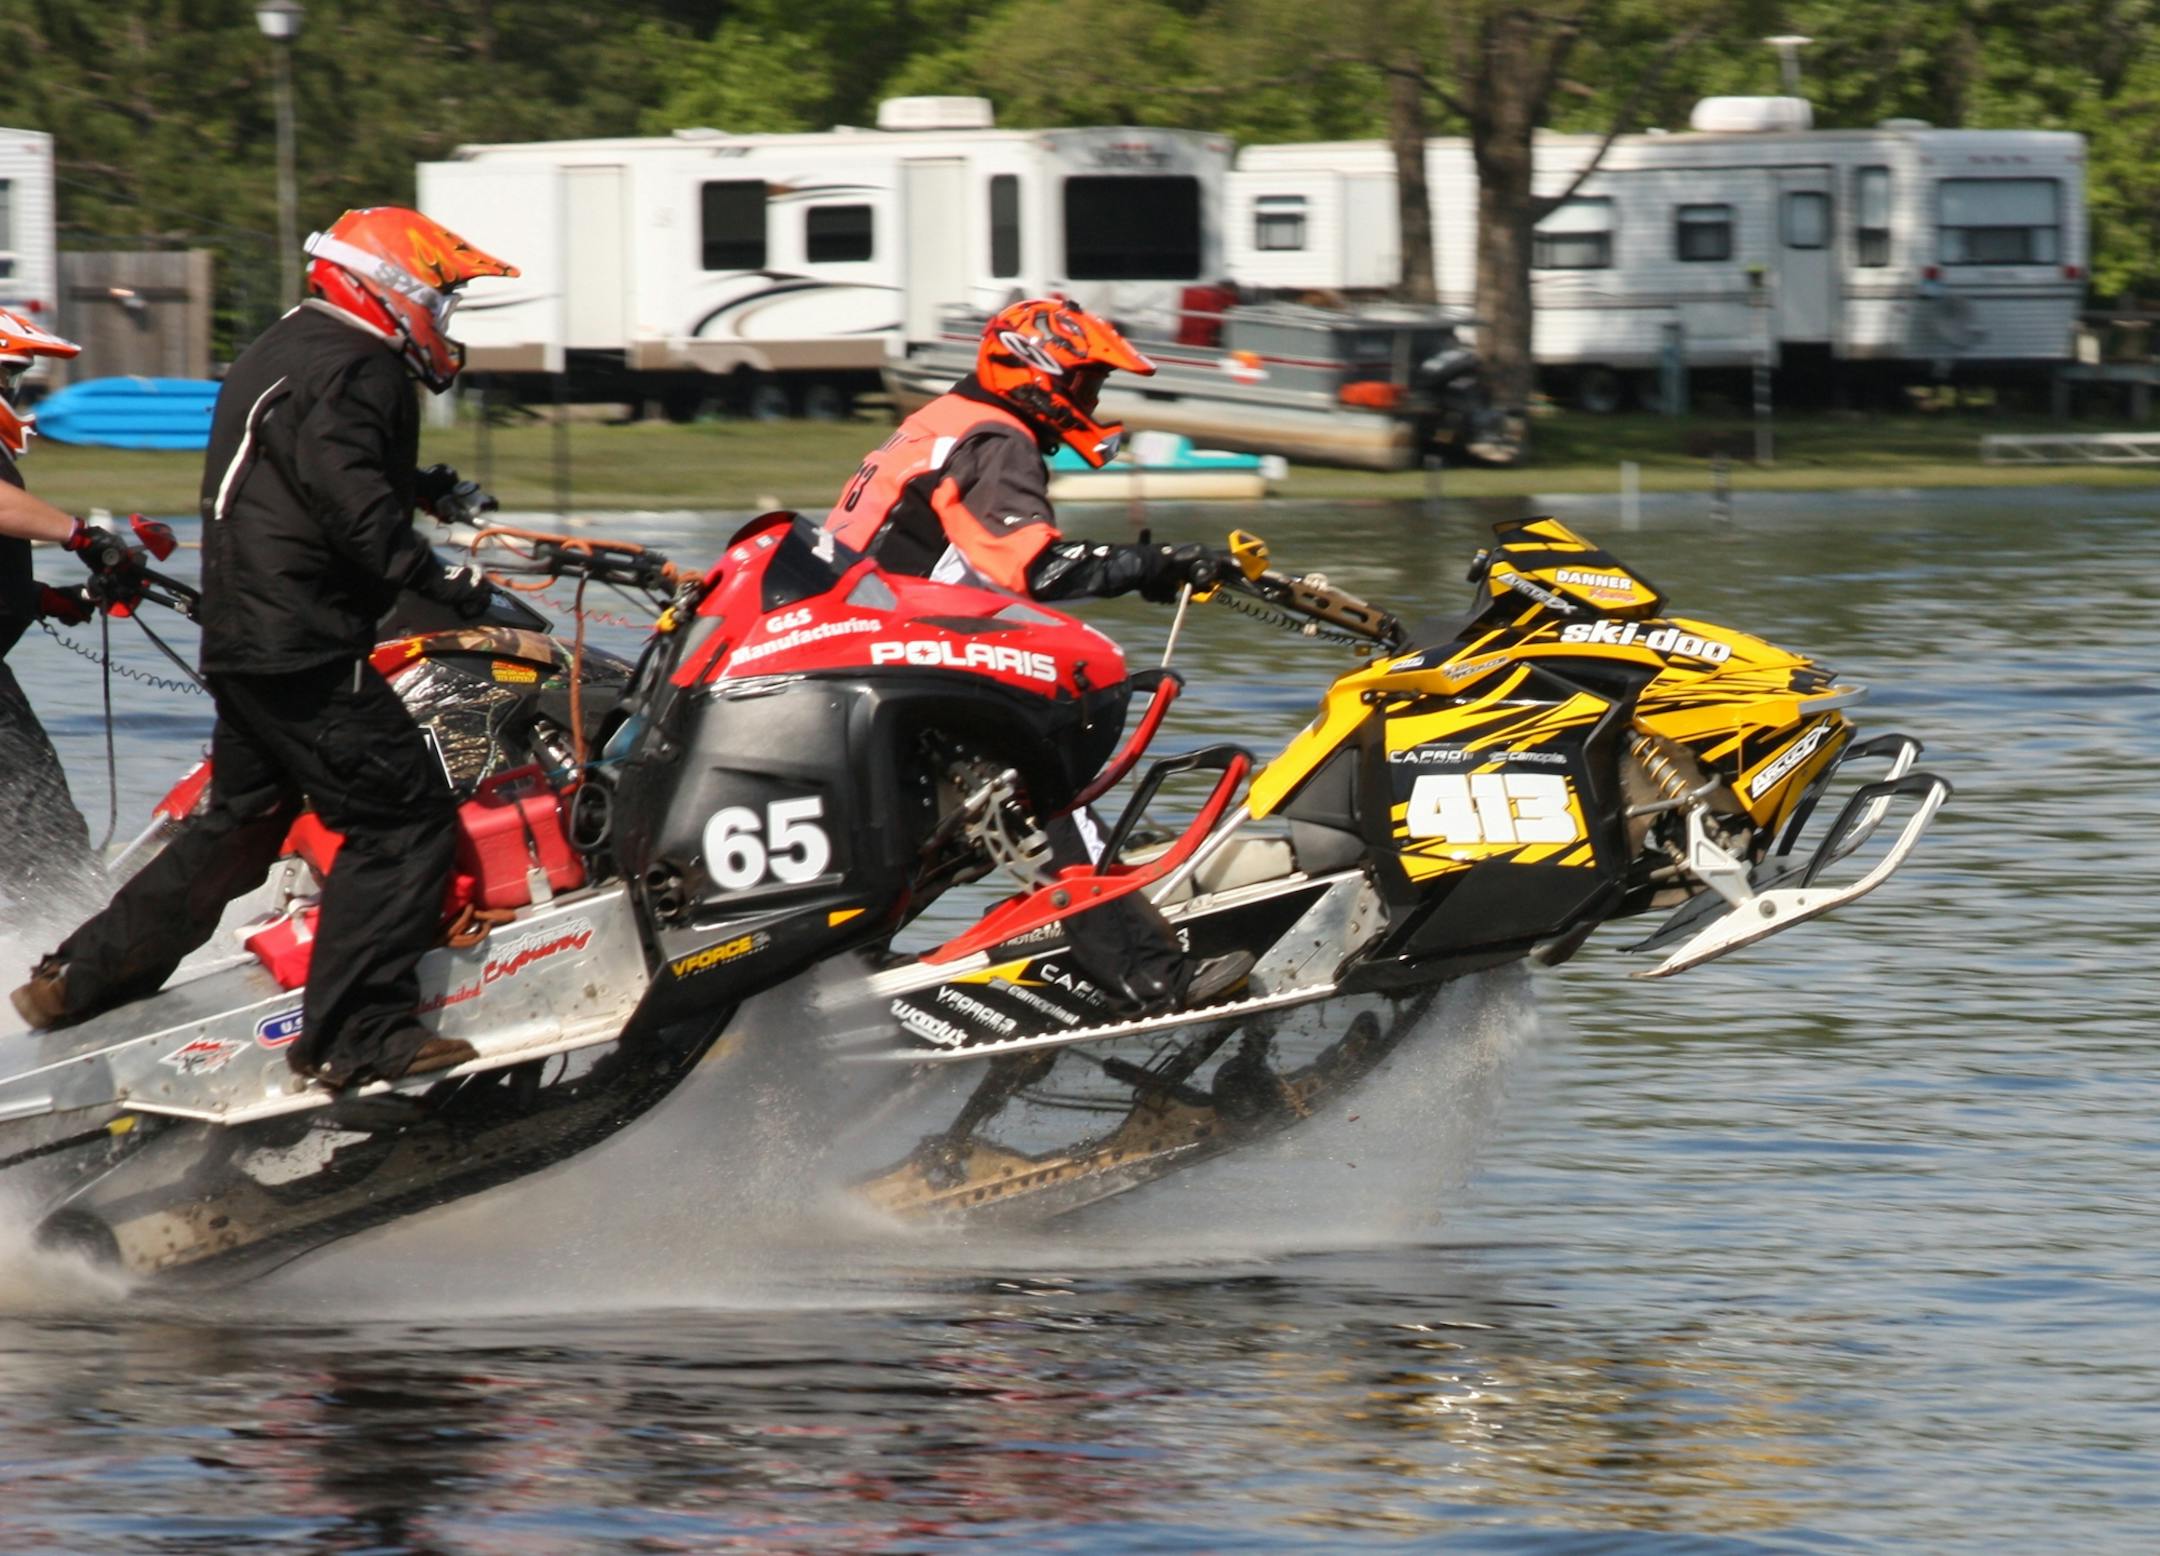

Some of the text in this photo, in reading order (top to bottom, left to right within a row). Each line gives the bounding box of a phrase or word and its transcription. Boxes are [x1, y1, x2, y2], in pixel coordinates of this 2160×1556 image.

[1556, 569, 1632, 590] DANNER
[731, 617, 882, 666] Manufacturing
[766, 608, 813, 633] G&S
[1560, 619, 1732, 663] ski-doo
[870, 640, 1057, 682] POLARIS
[1406, 773, 1579, 844] 413
[702, 795, 831, 891] 65
